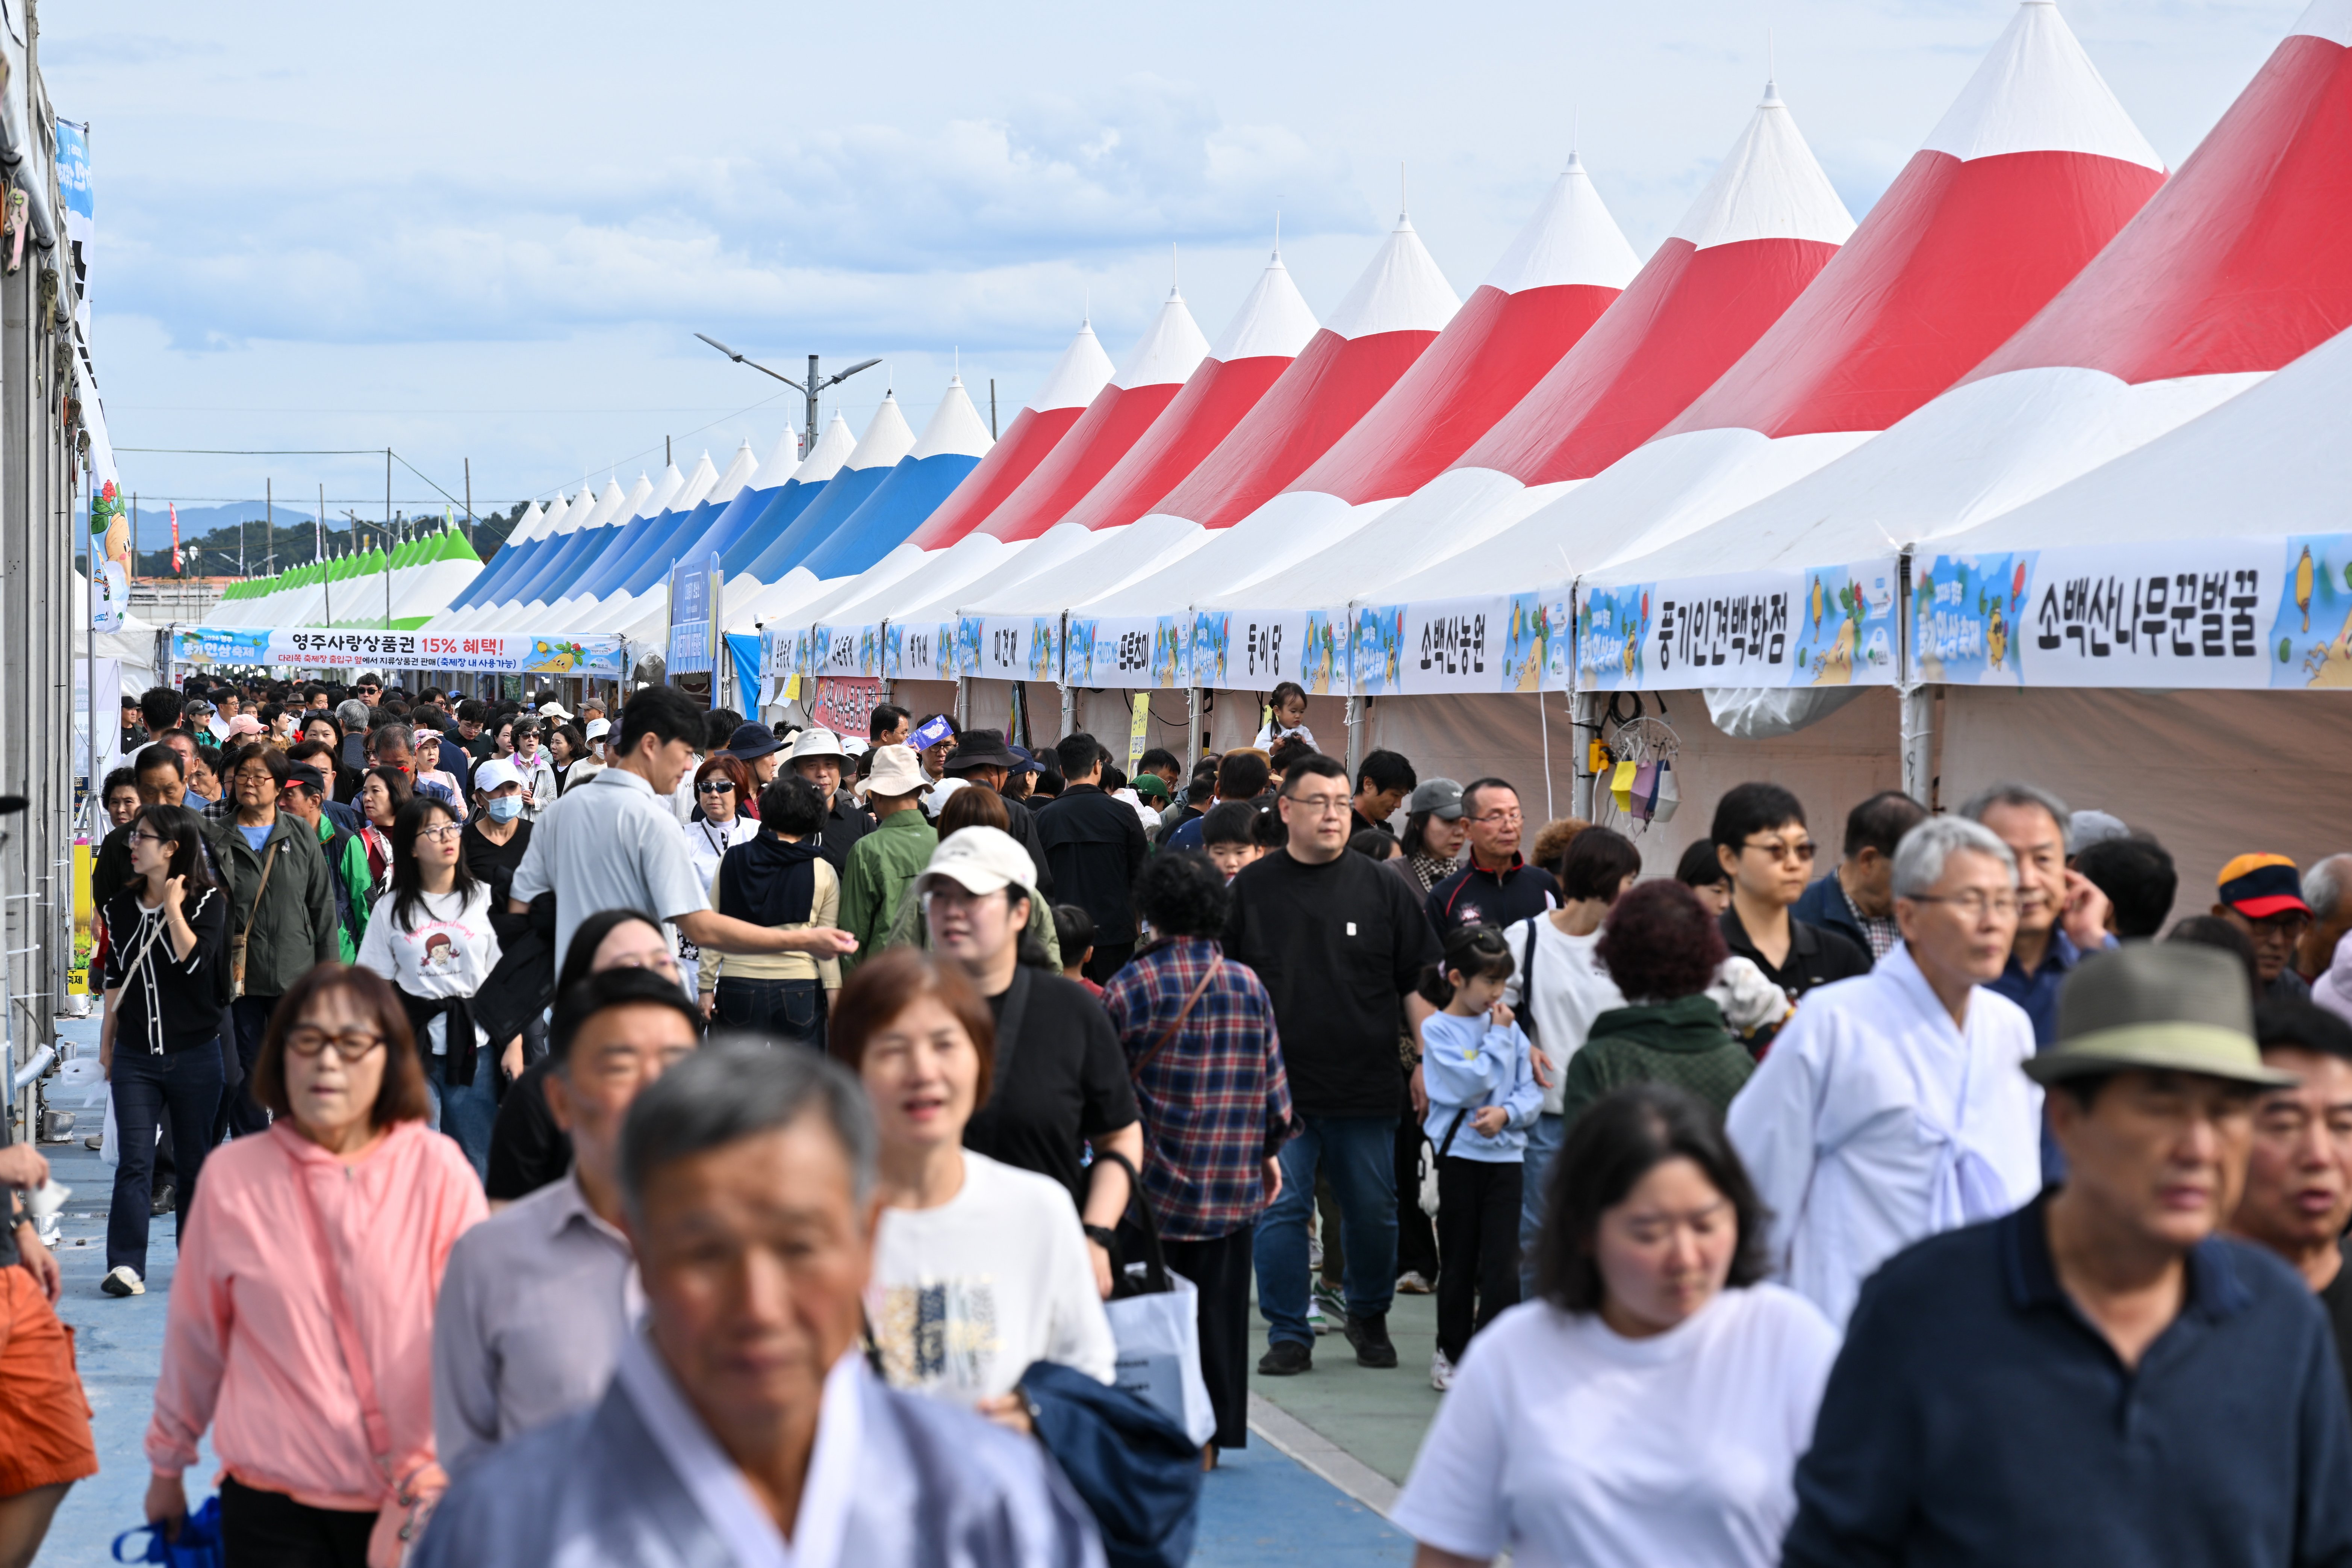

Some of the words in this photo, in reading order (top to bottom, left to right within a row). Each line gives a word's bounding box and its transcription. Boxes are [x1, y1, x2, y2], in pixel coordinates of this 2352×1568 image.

[1658, 592, 1788, 671] 풍기인견백화점
[2038, 569, 2259, 657] 소백산나무꾼벌꿀
[183, 642, 255, 658] 풍기인삼축제
[292, 634, 414, 653] 영주사랑상품권
[422, 638, 457, 653] 15%
[463, 639, 503, 656] 혜택!
[994, 627, 1017, 667] 미견재
[1119, 630, 1149, 674] 프루츠미
[1248, 624, 1282, 676] 둥이당
[1420, 614, 1485, 675] 소백산농원
[1580, 633, 1622, 672] 풍기인삼축제
[1919, 610, 1982, 660] 풍기인삼축제
[278, 654, 301, 663] 다리쪽
[304, 654, 327, 663] 축제장
[330, 655, 352, 664] 출입구
[354, 656, 378, 664] 옆에서
[380, 657, 418, 666] 지류상품권
[468, 659, 477, 667] 내
[479, 659, 516, 669] 사용가능)
[1193, 645, 1215, 674] 풍기인삼축제
[1354, 646, 1385, 680] 풍기인삼축제
